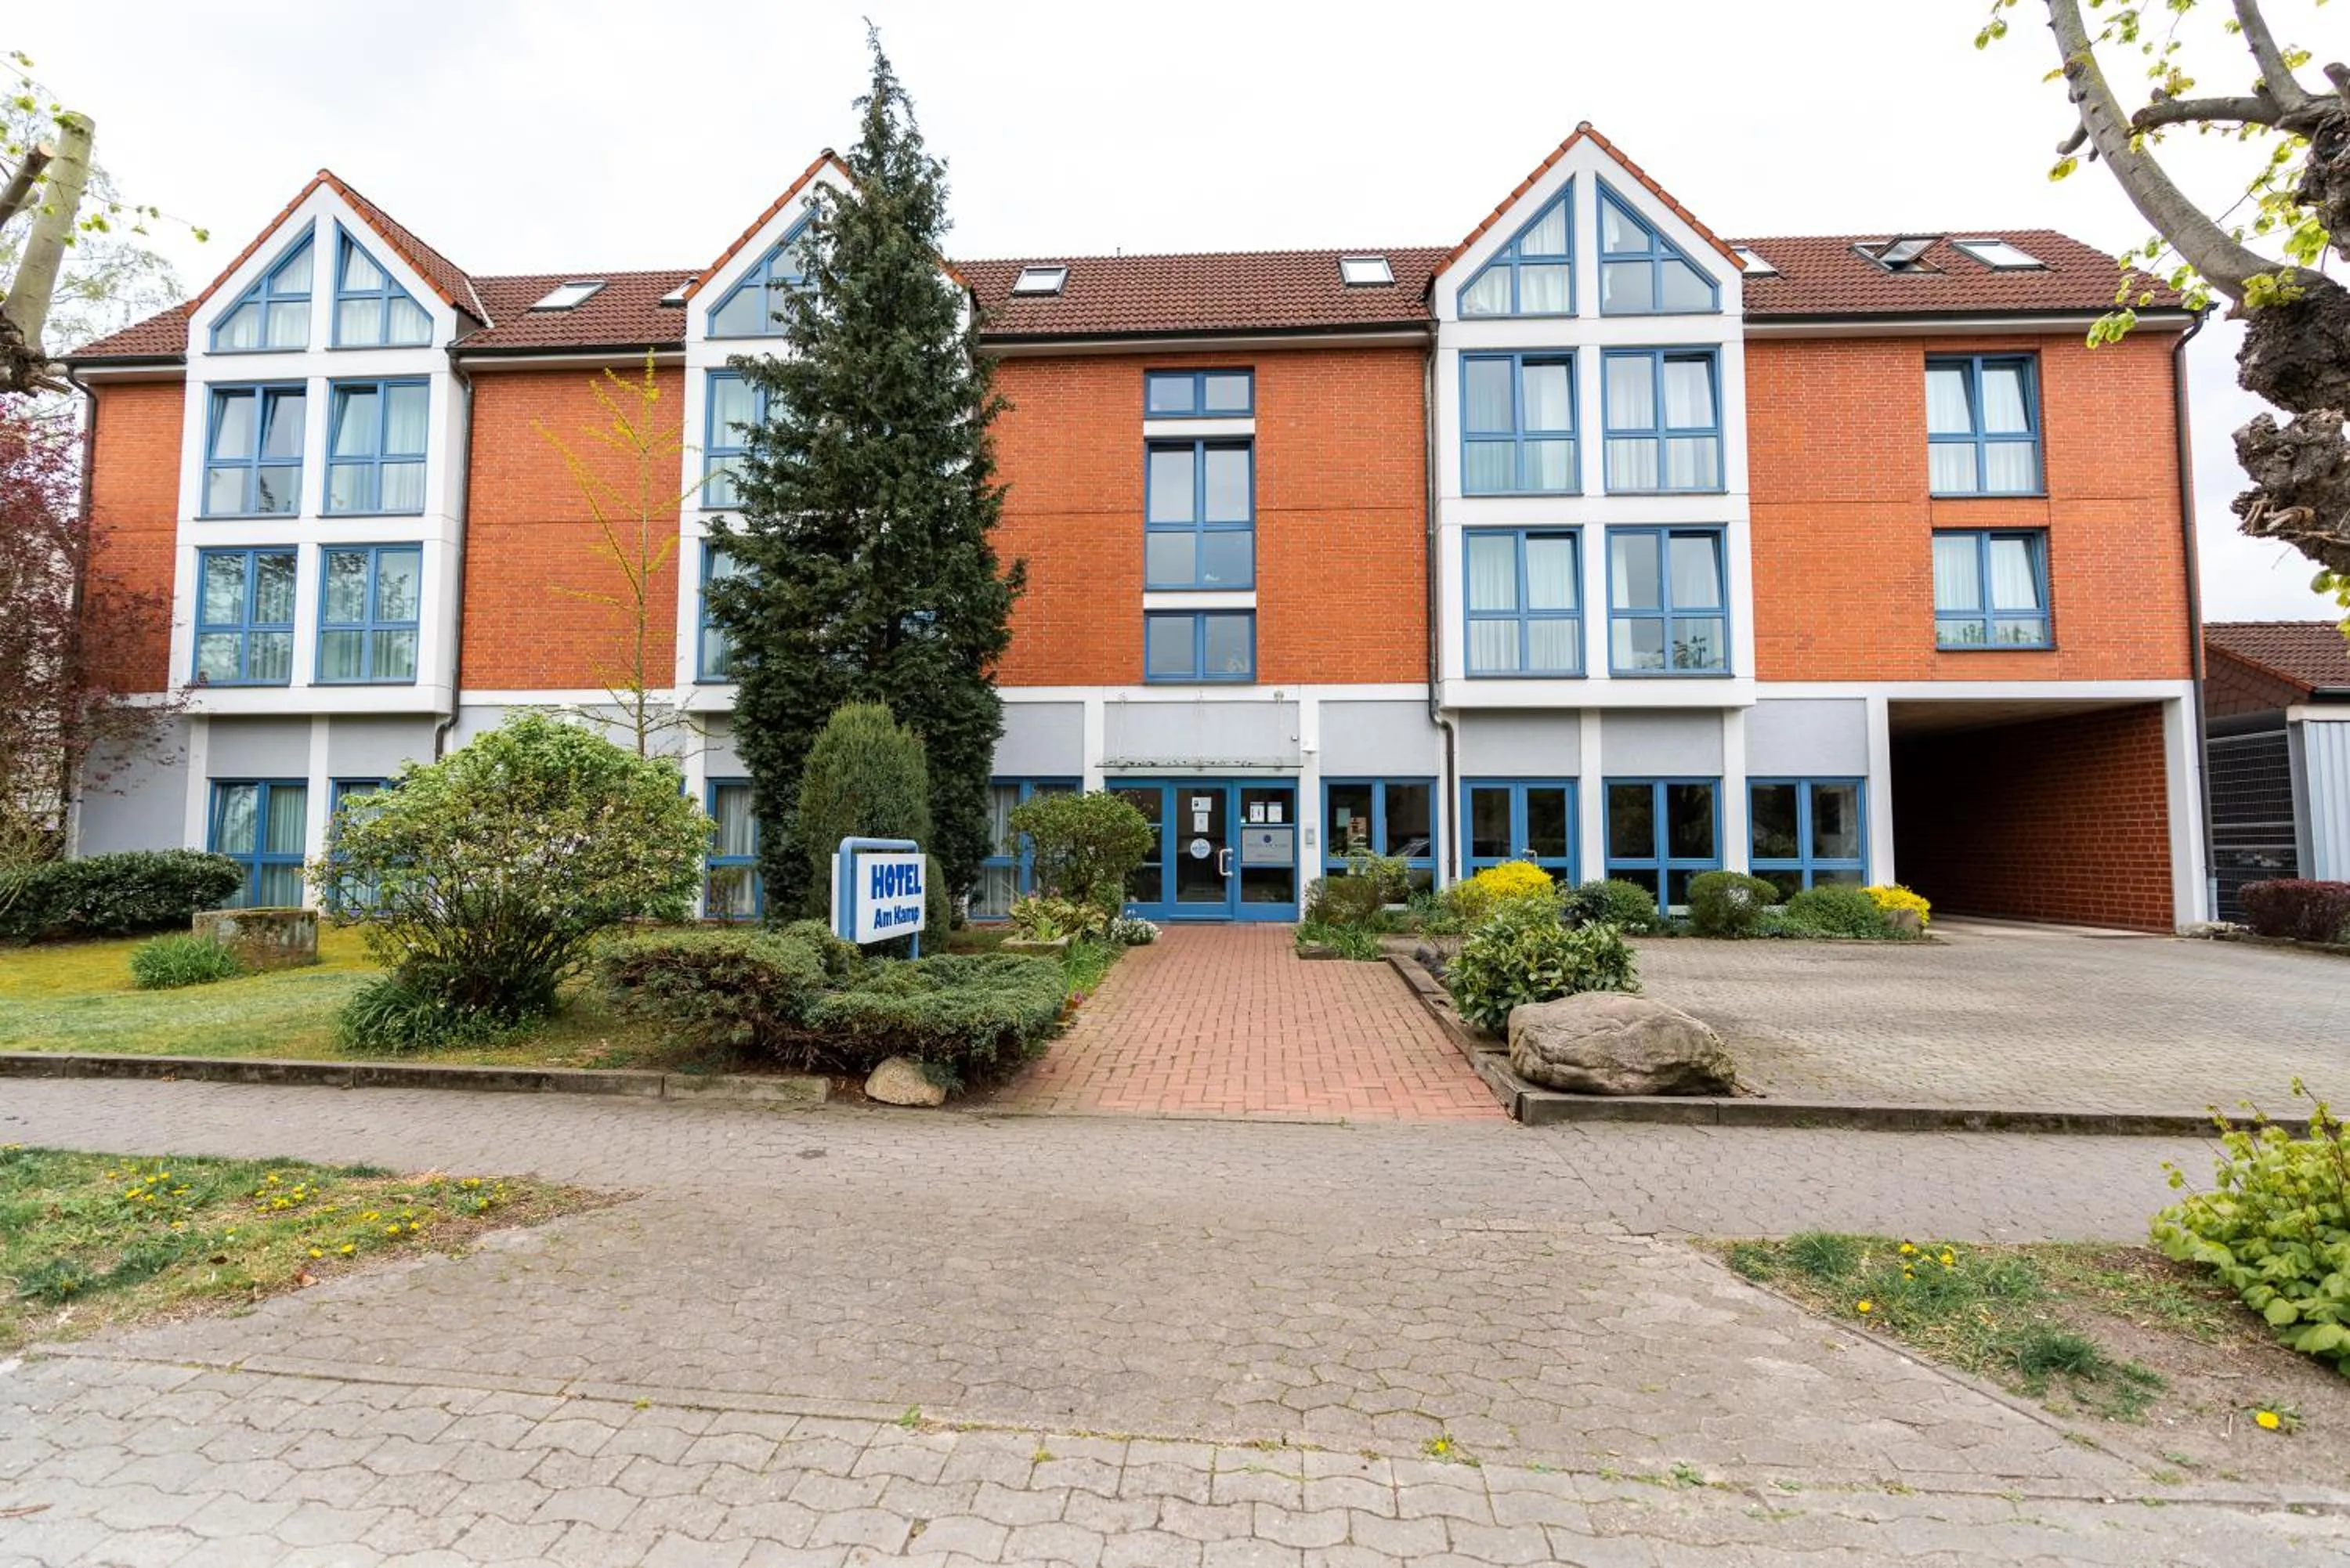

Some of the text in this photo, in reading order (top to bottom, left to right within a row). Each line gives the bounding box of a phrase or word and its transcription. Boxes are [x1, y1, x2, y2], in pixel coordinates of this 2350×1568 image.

[871, 864, 921, 899] HOTEL
[873, 905, 920, 930] Am Kamp
